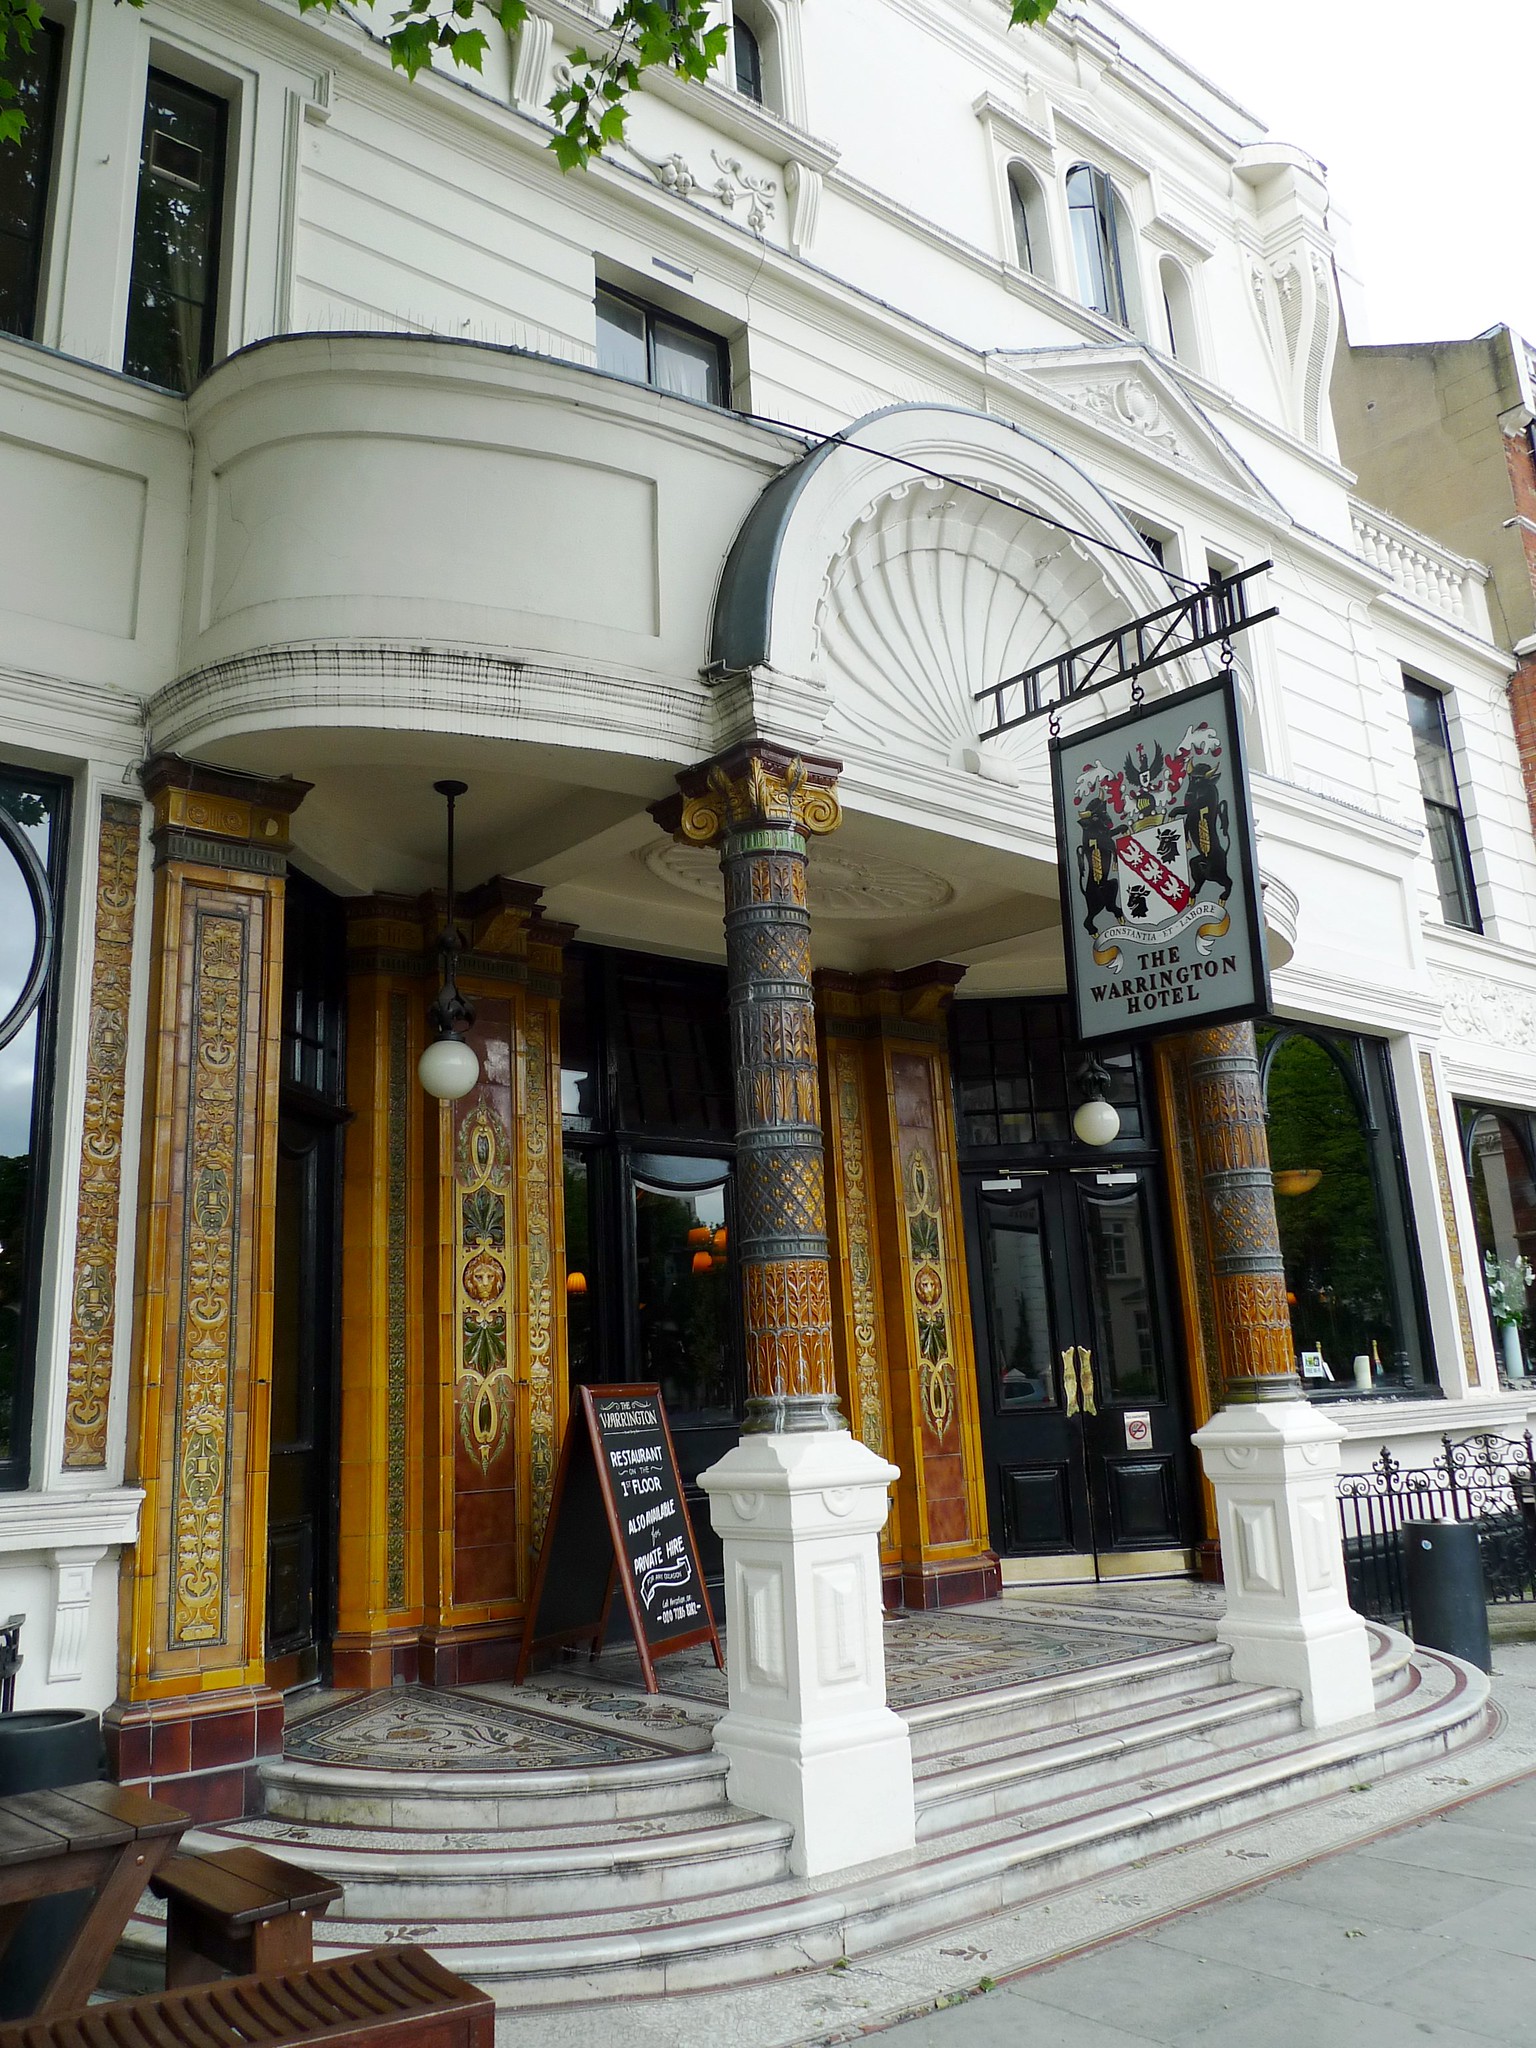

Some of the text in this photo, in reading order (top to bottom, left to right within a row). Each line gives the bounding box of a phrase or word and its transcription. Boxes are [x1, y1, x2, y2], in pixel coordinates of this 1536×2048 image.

[1104, 905, 1217, 941] CONSTANTIA ET LABORE
[1137, 946, 1180, 971] THE
[1090, 955, 1237, 1003] WARRINGTON
[1127, 985, 1200, 1015] HOTEL
[620, 1401, 631, 1410] THE
[599, 1410, 658, 1428] WARRINGTON
[610, 1446, 662, 1467] RESTAURANT
[639, 1465, 650, 1474] THE
[621, 1476, 663, 1497] 1ST FLOOR
[628, 1498, 676, 1535] ALSO AVAILABLE
[651, 1526, 661, 1547] for
[634, 1535, 685, 1576] PRIVATE HIRE
